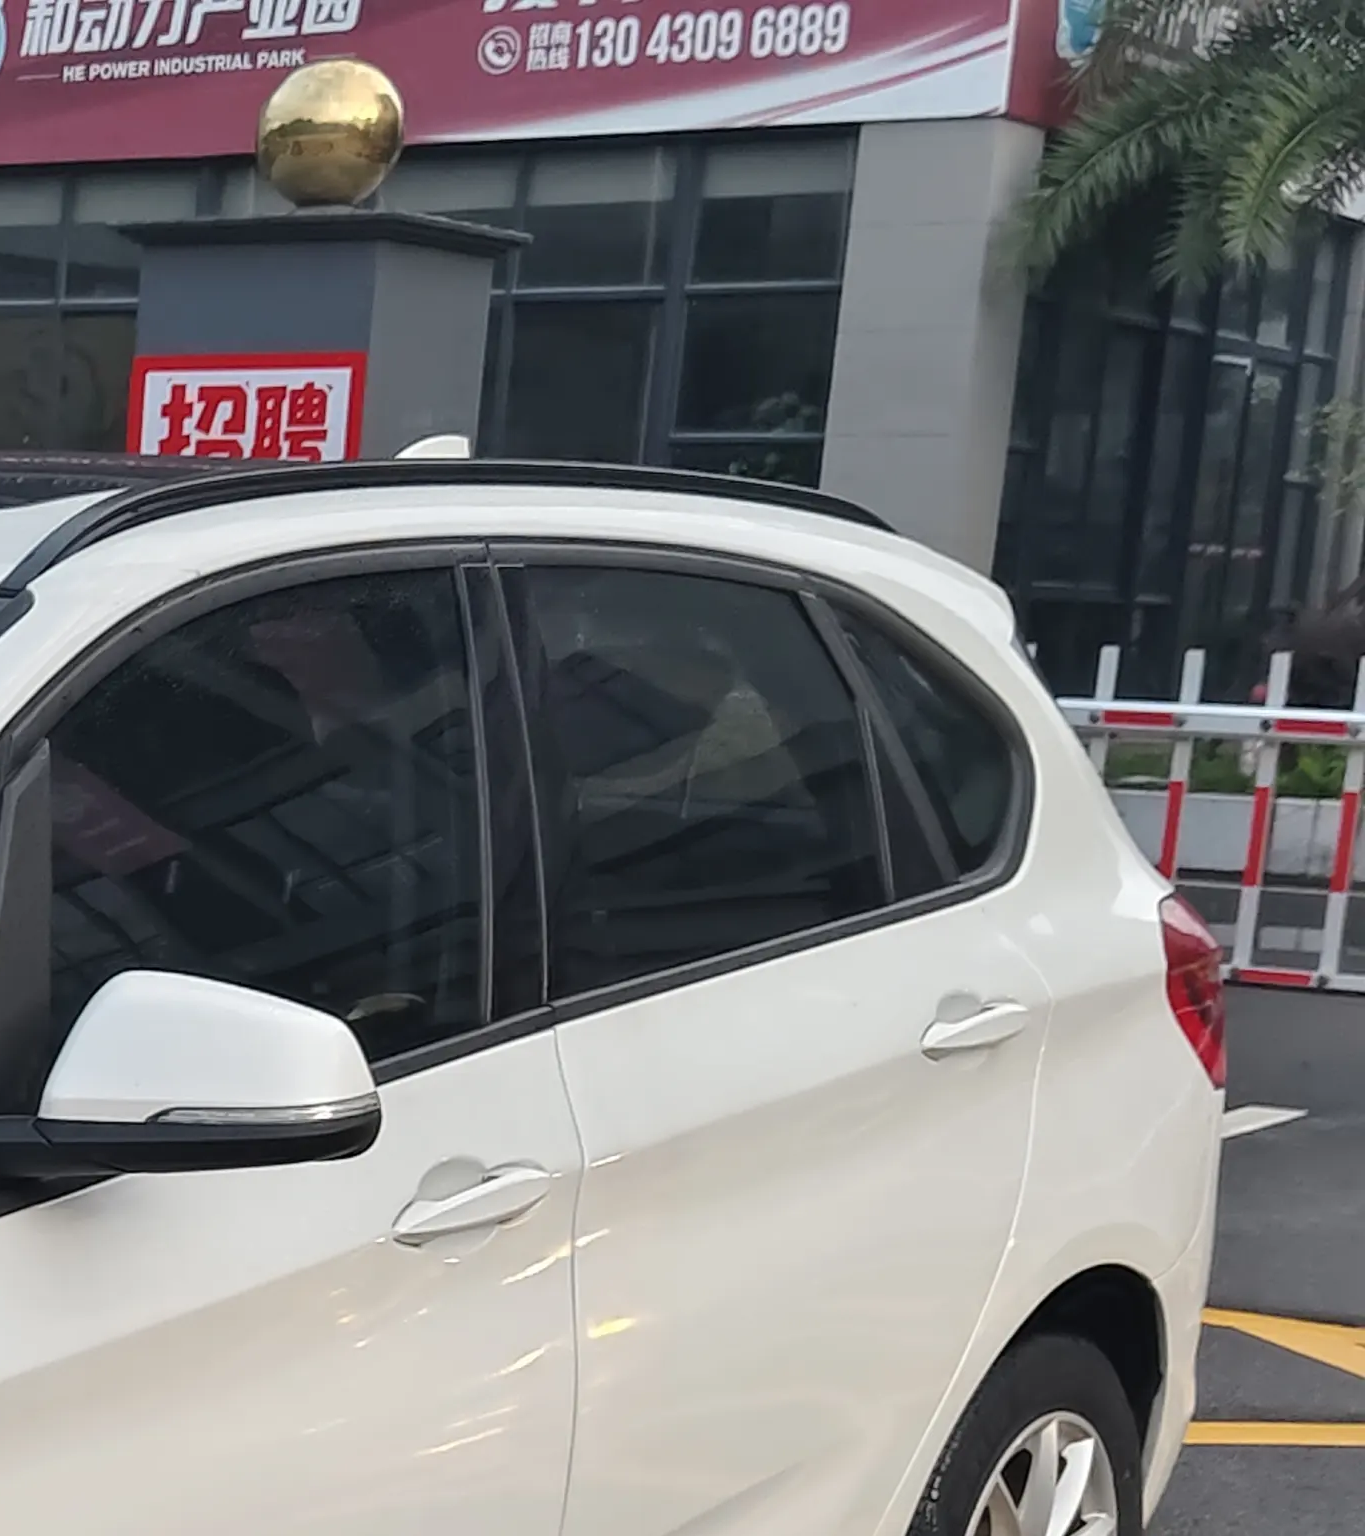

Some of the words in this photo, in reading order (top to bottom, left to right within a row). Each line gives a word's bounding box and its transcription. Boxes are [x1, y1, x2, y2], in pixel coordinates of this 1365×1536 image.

[62, 64, 86, 82] HE
[89, 60, 151, 80] POWER
[153, 52, 253, 76] INDUSTRIAL
[256, 48, 306, 68] PARK
[575, 15, 640, 69] 130
[645, 8, 744, 64] 4309
[749, 1, 851, 58] 6889
[157, 381, 329, 461] 招聘
